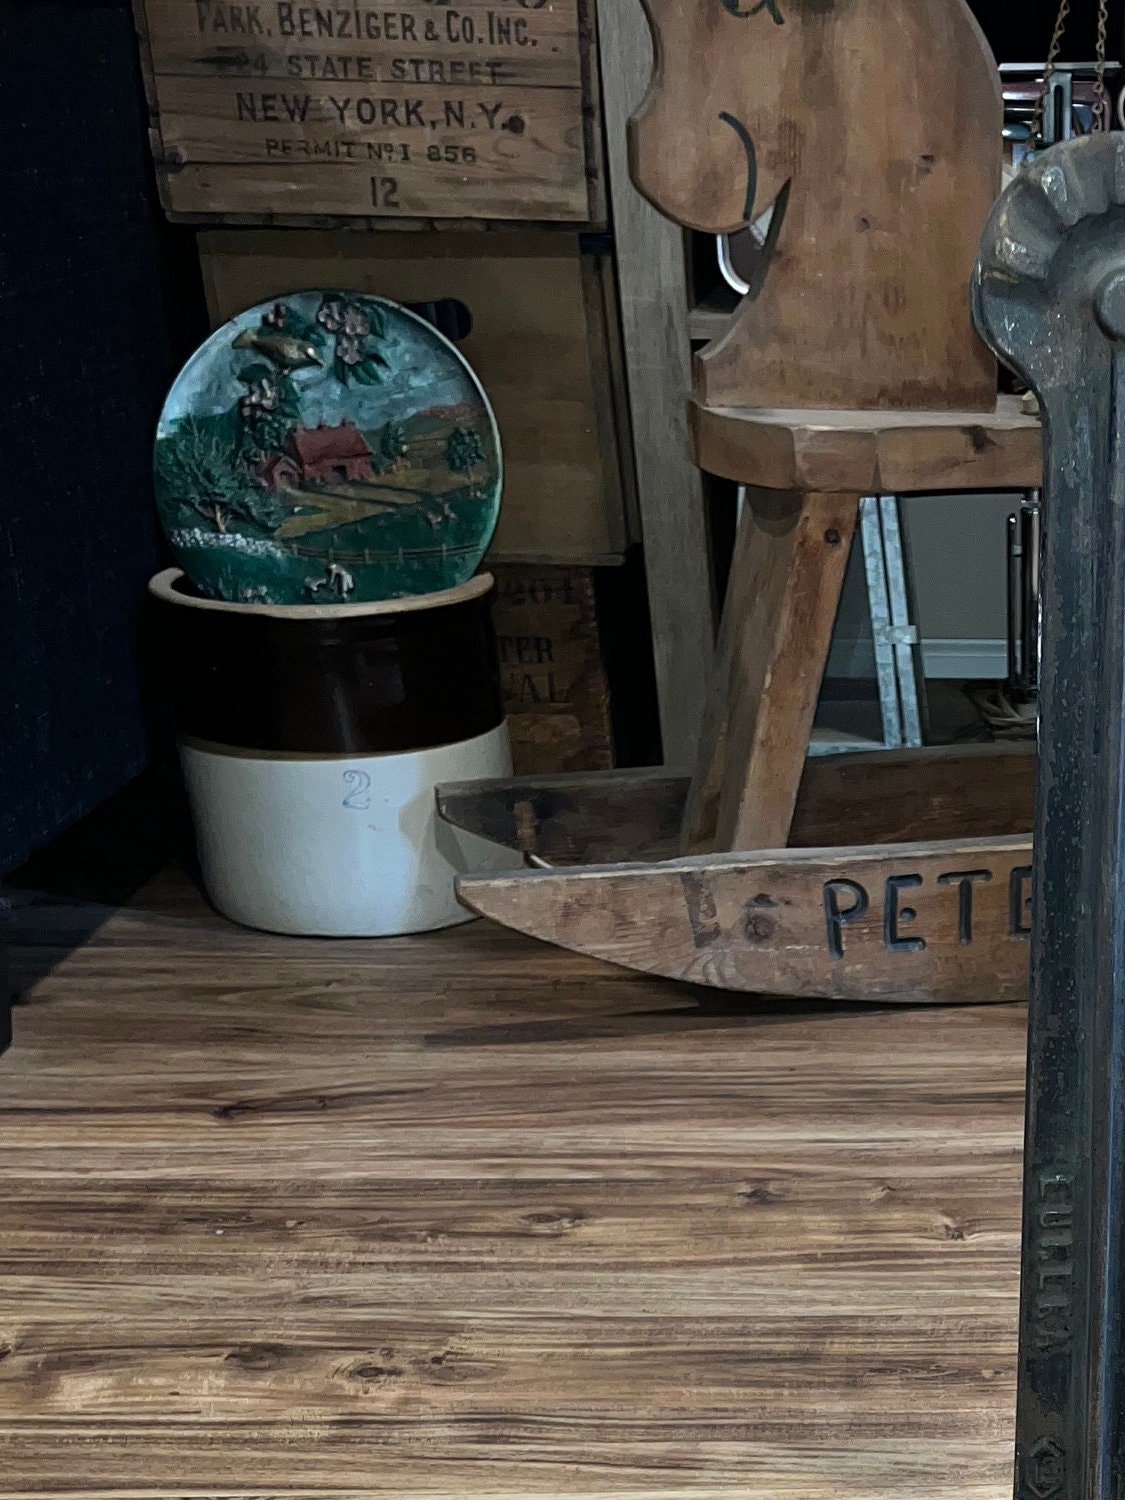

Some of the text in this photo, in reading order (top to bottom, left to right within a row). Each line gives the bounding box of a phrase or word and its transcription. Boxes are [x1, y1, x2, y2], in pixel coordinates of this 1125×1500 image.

[279, 2, 417, 41] BENZIGER
[425, 22, 440, 42] &
[288, 55, 372, 79] STATE
[390, 58, 504, 85] STREET
[236, 92, 311, 122] NEW
[265, 139, 358, 159] PERMIT
[370, 176, 400, 208] 12
[342, 769, 372, 810] 2
